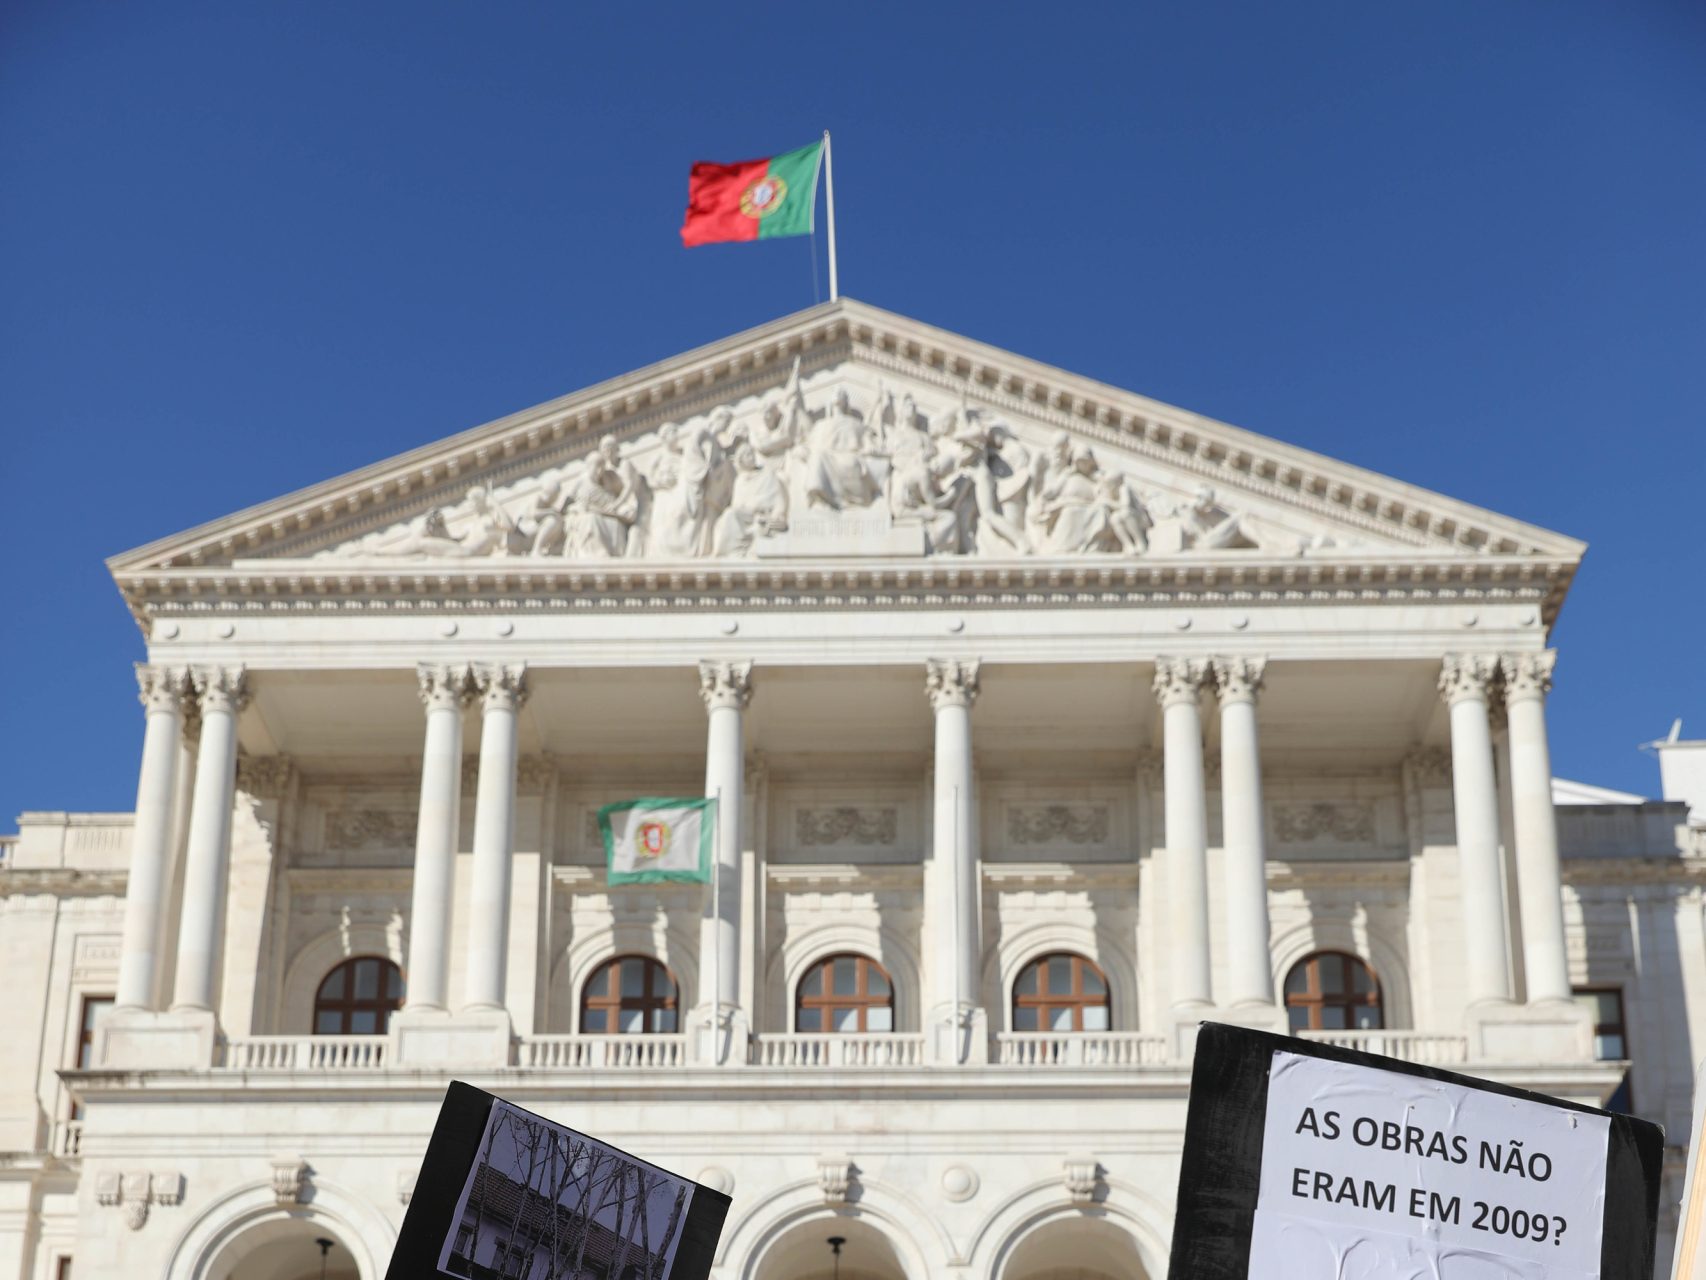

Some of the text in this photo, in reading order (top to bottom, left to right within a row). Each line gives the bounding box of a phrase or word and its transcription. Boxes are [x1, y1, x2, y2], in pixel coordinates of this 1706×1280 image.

[1295, 1107, 1552, 1182] AS OBRAS NÃO
[1292, 1168, 1567, 1246] ERAM EM 2009?
